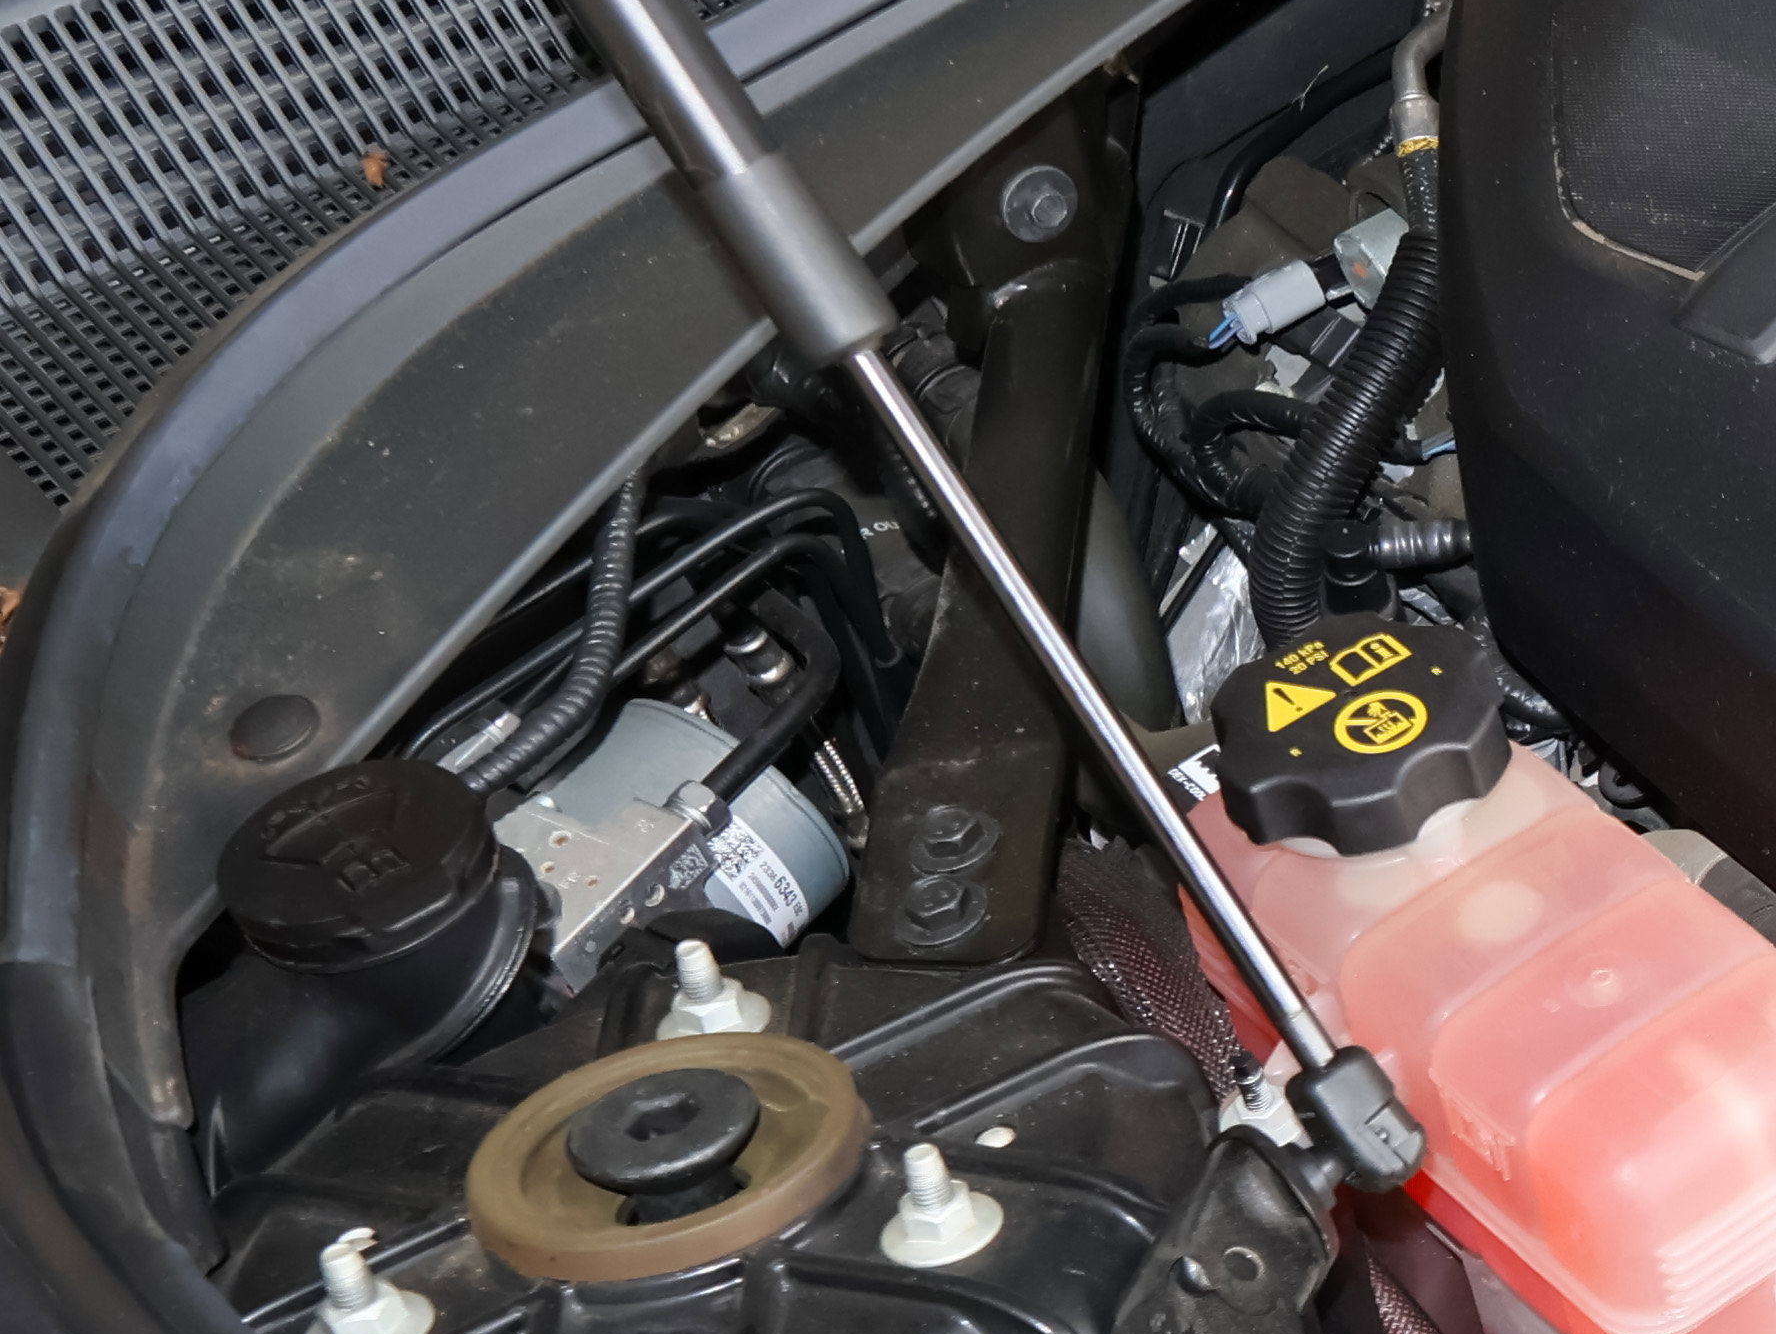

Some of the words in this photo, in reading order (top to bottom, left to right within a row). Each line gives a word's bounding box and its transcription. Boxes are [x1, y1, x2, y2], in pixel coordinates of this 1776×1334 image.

[1275, 653, 1299, 669] 140
[1297, 642, 1324, 657] kPa
[1289, 662, 1307, 674] 20
[1306, 650, 1329, 665] PSI
[1167, 768, 1206, 801] DEX-COOL
[774, 875, 798, 907] 6343
